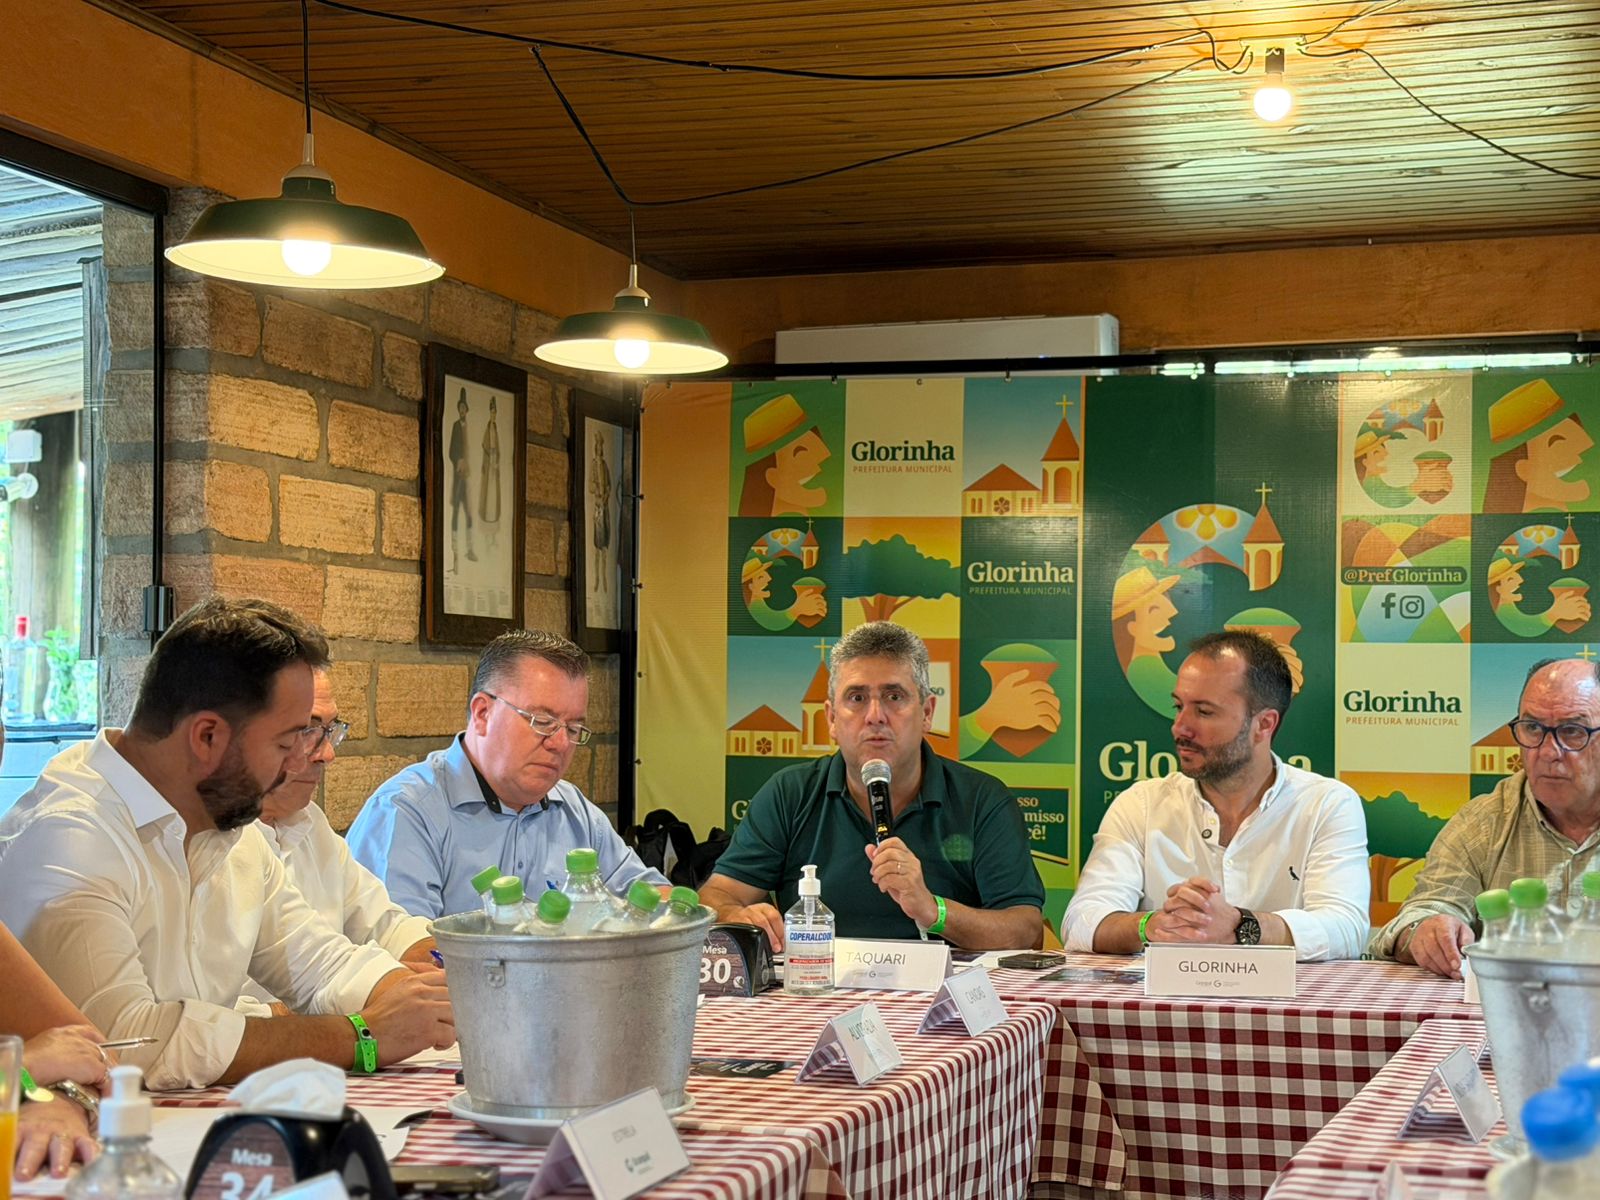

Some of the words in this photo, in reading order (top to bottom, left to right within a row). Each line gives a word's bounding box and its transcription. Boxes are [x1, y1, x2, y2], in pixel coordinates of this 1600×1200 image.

[851, 440, 955, 462] Glorinha
[853, 464, 903, 474] PREFEITURA
[905, 464, 952, 474] MUNICIPAL
[967, 561, 1074, 583] Glorinha
[1344, 568, 1463, 584] @PrefGlorinha
[969, 586, 1021, 595] PREFEITURA
[1023, 587, 1073, 596] MUNICIPAL
[1343, 690, 1462, 714] Glorinha
[1346, 716, 1402, 726] PREFEITURA
[1405, 717, 1459, 727] MUNICIPAL
[702, 944, 728, 955] Mesa
[846, 951, 906, 966] TAQUARI
[698, 957, 731, 984] 30
[1178, 960, 1259, 975] GLORINHA
[231, 1148, 273, 1167] Mesa
